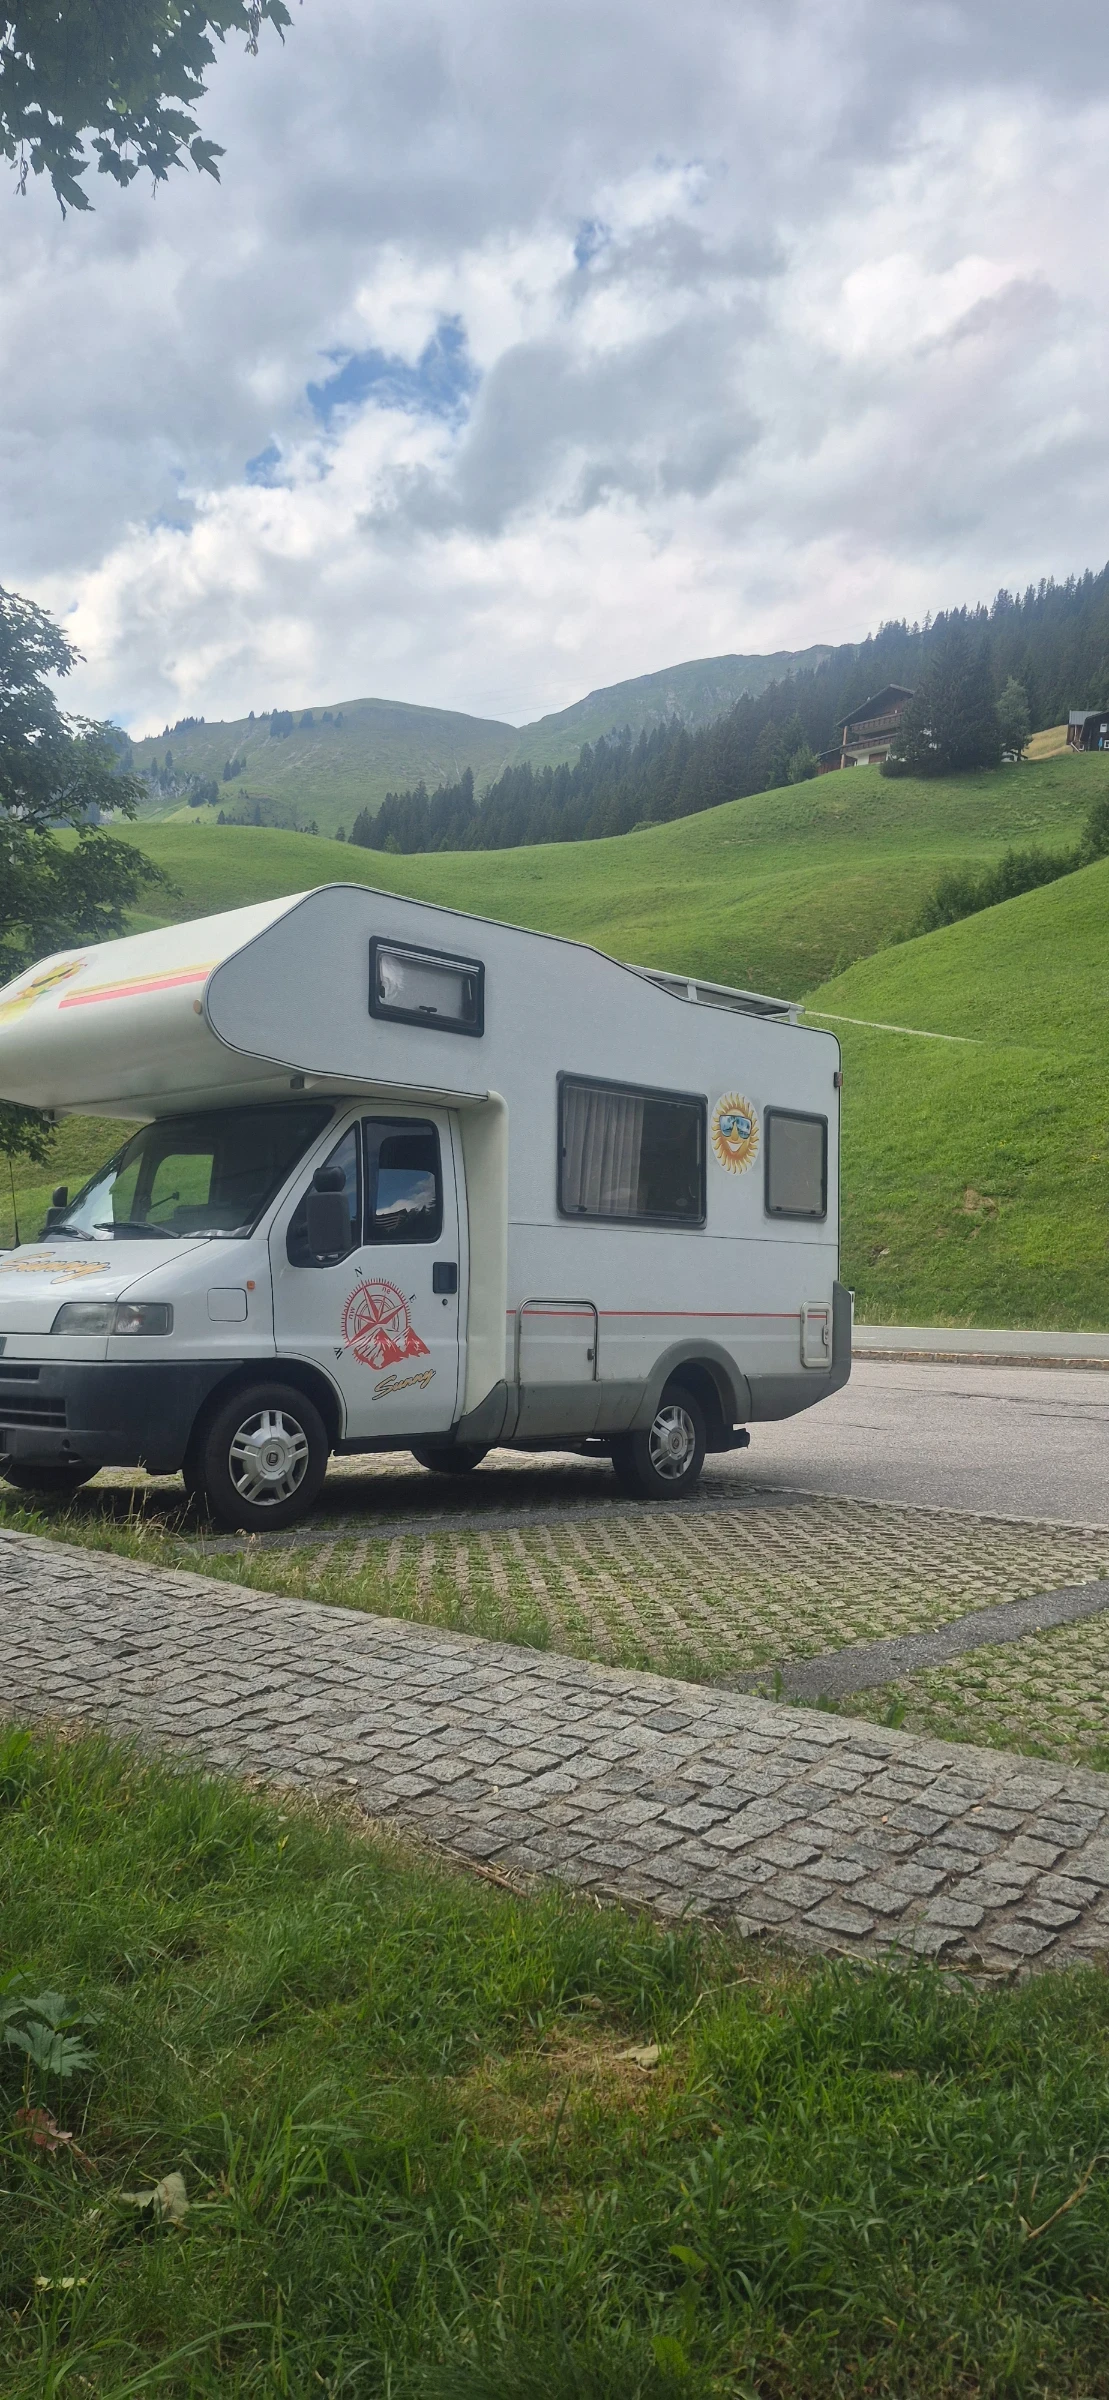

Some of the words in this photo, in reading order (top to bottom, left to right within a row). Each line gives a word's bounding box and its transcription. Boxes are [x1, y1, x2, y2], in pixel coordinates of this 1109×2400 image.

[0, 1252, 111, 1284] Sunny
[354, 1266, 363, 1278] N
[381, 1286, 391, 1295] ne
[408, 1293, 417, 1304] E
[371, 1368, 437, 1401] Sunny
